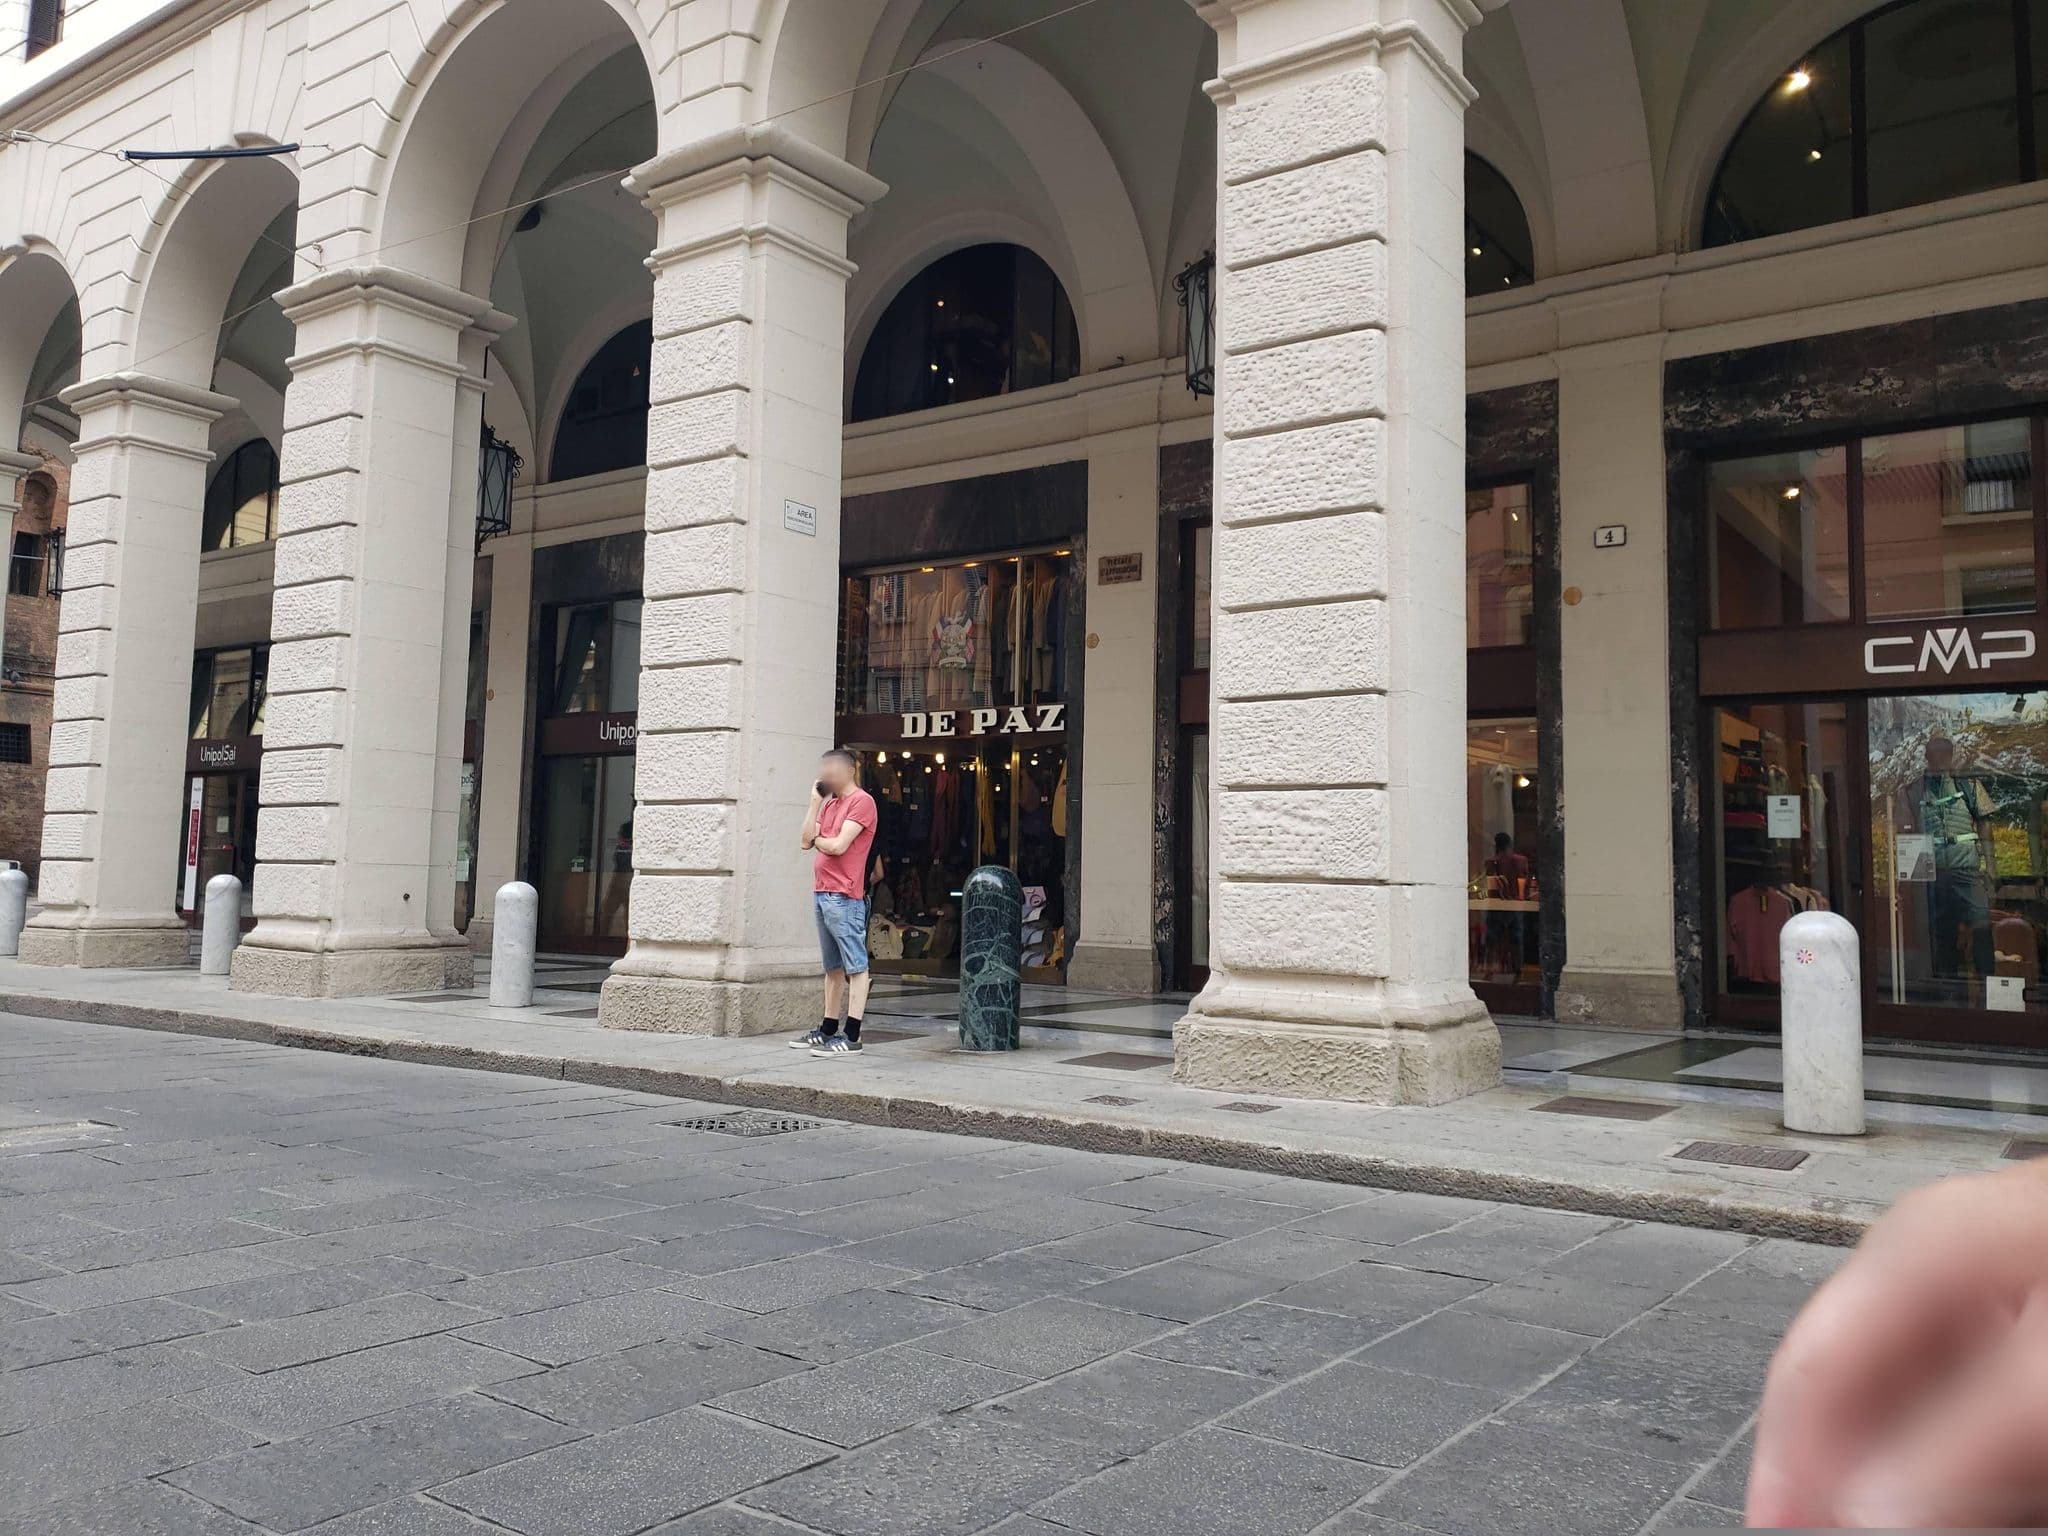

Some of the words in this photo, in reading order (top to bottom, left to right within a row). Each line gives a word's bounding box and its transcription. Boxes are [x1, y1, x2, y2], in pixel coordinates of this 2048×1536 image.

[797, 509, 812, 520] AREA
[1604, 530, 1615, 543] 4
[1864, 627, 2036, 674] CMP
[900, 710, 956, 738] DE
[970, 704, 1065, 735] PAZ
[200, 744, 237, 767] UnipolSai
